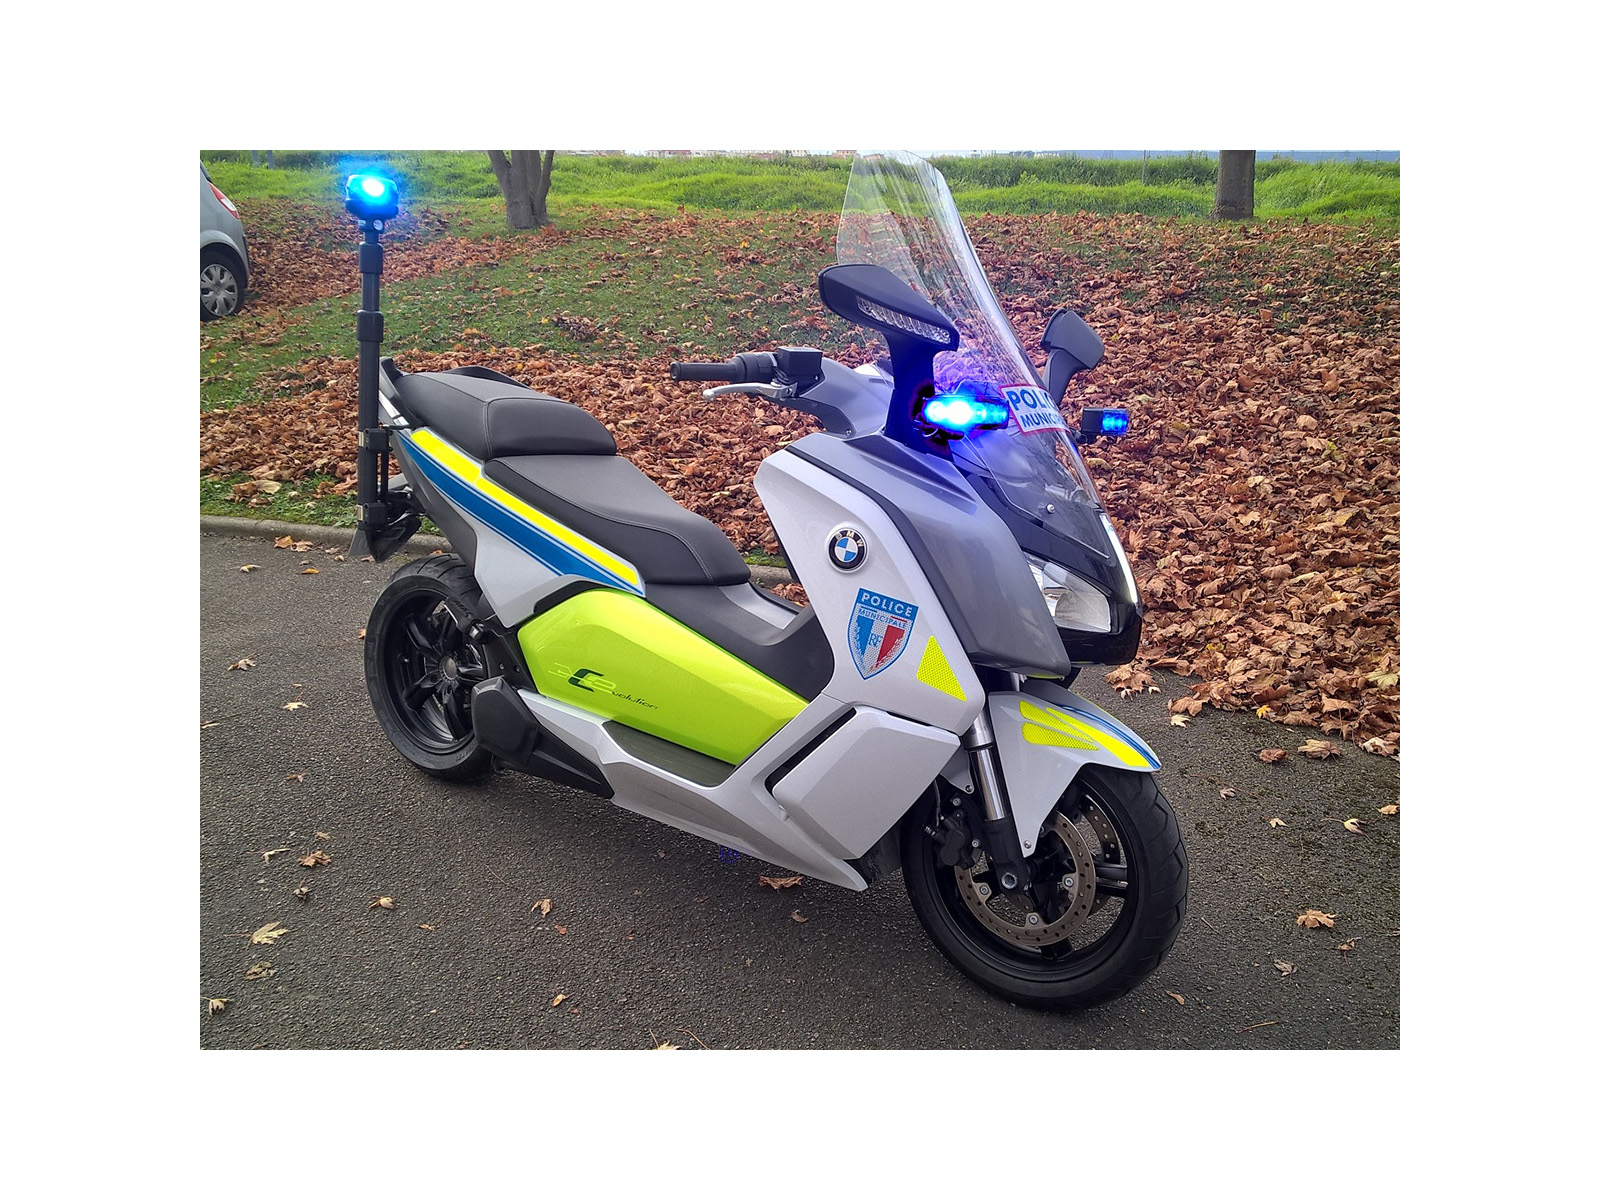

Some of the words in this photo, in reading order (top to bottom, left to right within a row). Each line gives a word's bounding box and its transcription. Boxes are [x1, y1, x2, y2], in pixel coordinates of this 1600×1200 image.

[835, 530, 864, 547] BMW
[861, 592, 913, 617] POLICE
[859, 608, 907, 629] MUNICIPALE
